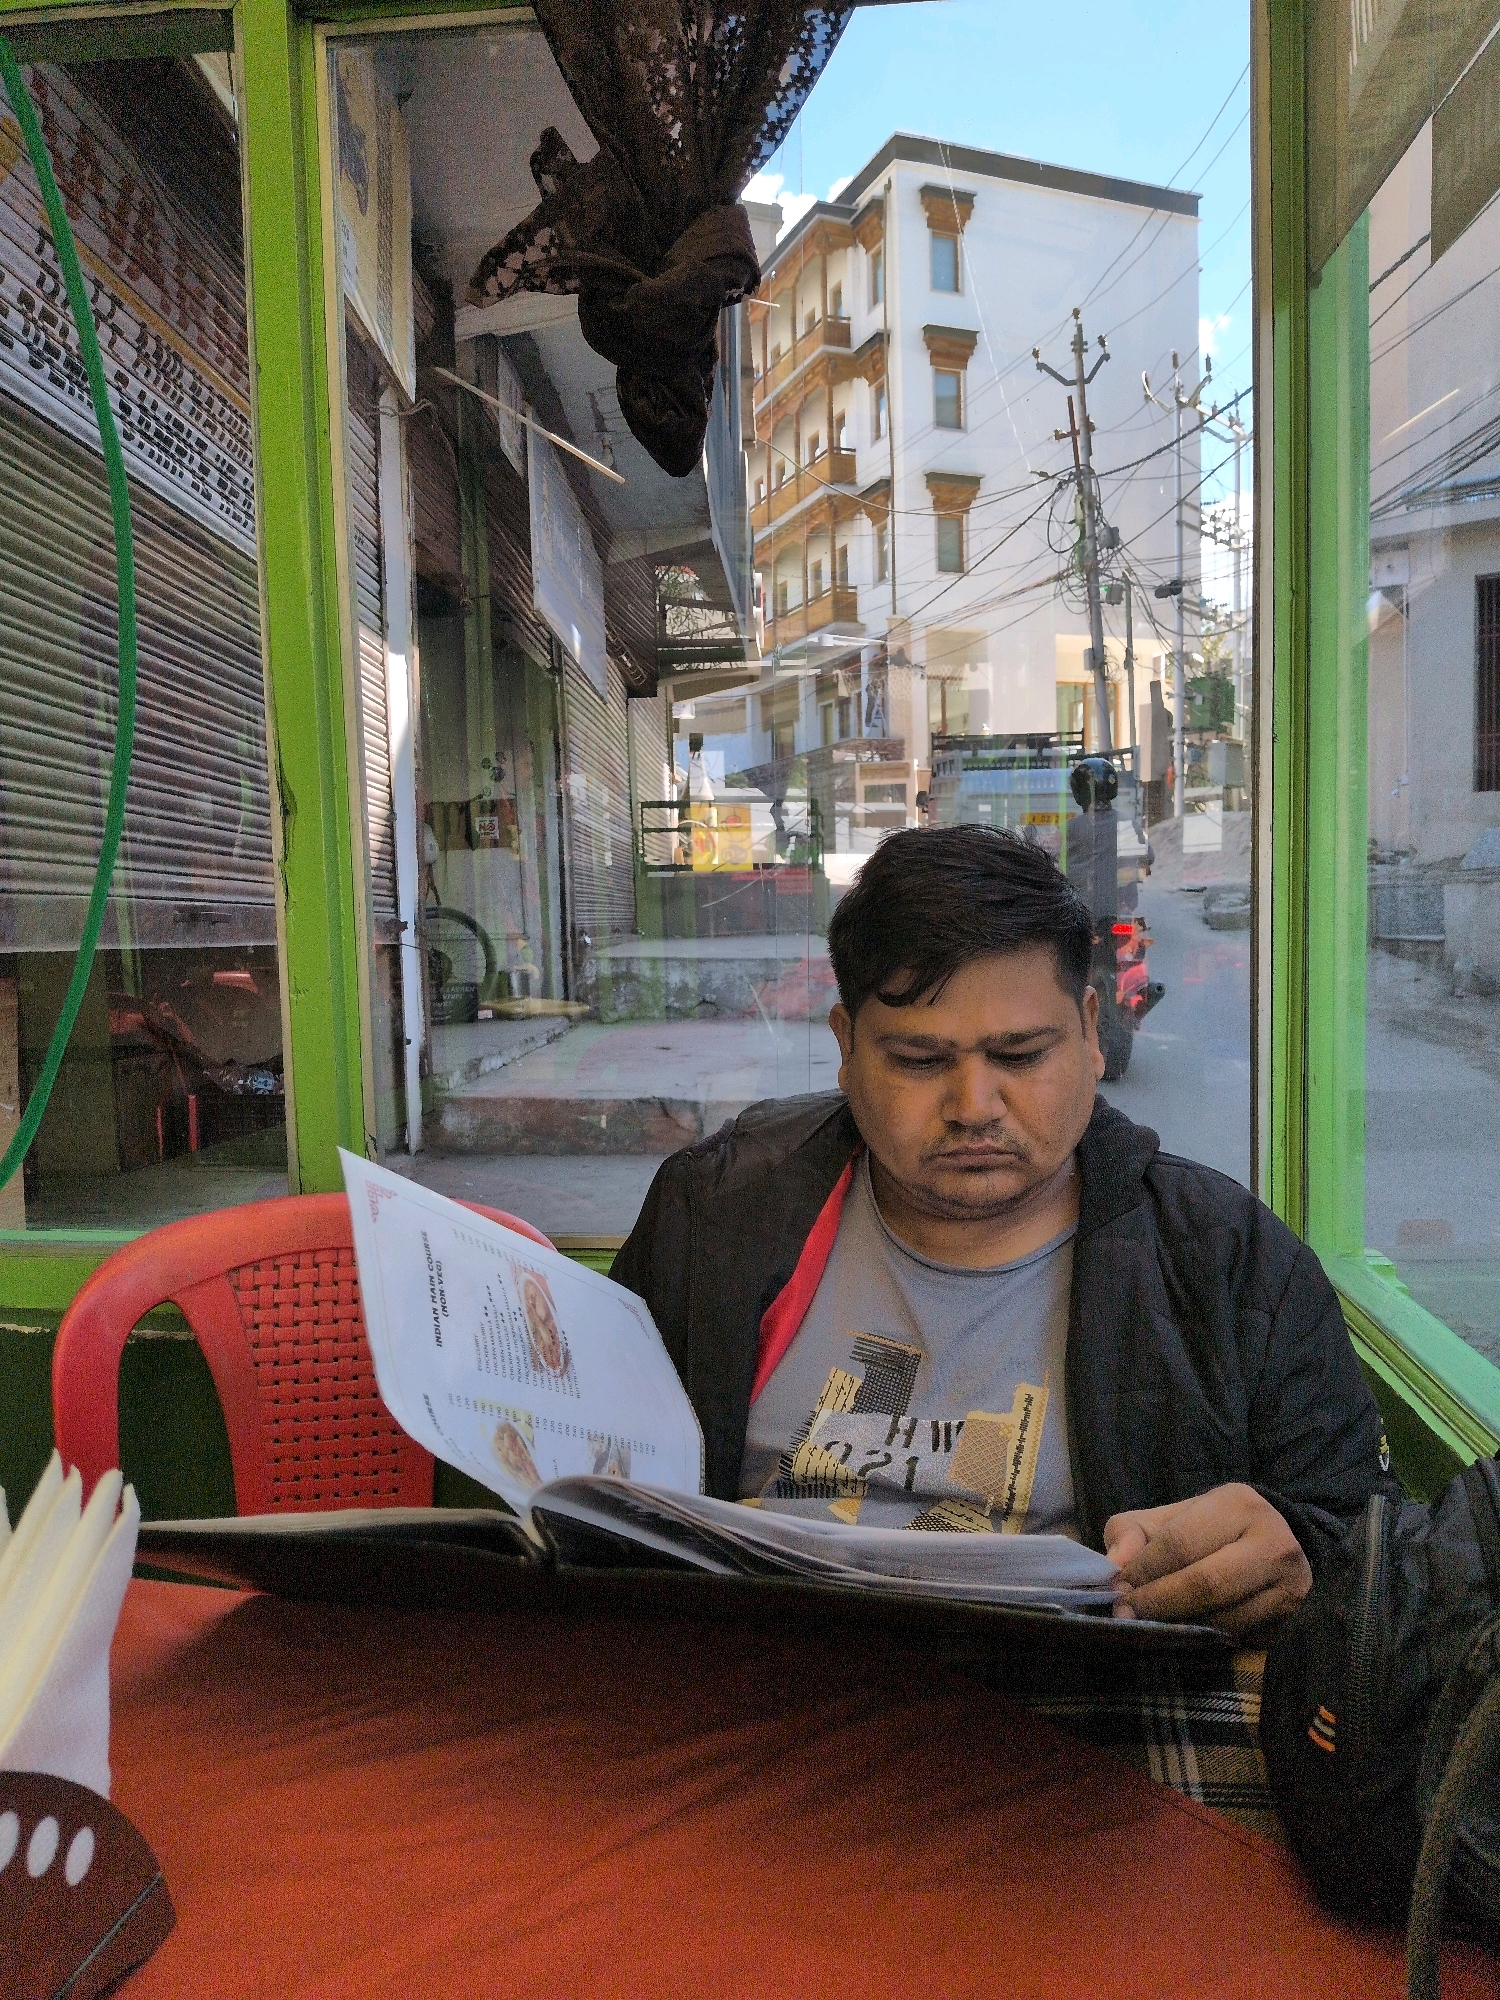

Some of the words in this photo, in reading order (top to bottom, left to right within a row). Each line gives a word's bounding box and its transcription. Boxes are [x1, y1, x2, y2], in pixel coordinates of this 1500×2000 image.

[421, 1231, 434, 1271] COURSE
[429, 1275, 438, 1304] MAIN
[436, 1261, 450, 1317] (NON-VEG)
[432, 1307, 443, 1347] INDIAN
